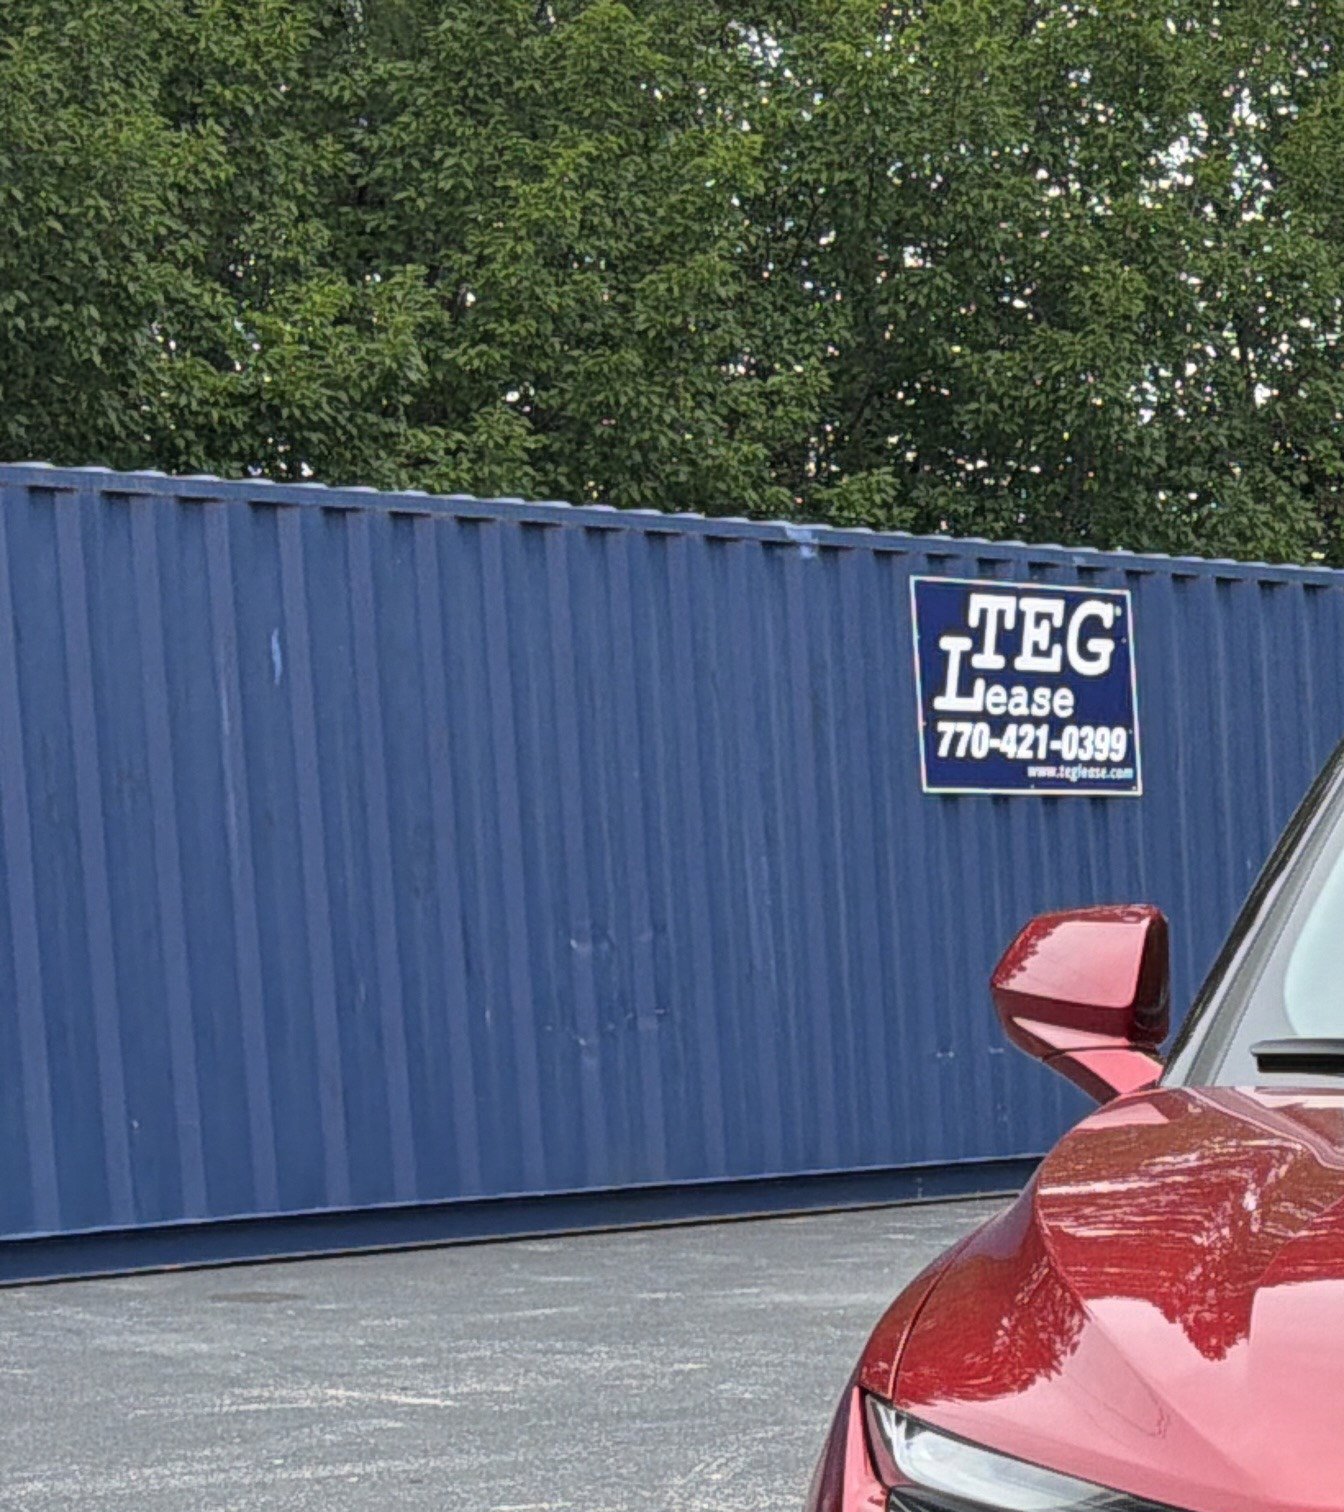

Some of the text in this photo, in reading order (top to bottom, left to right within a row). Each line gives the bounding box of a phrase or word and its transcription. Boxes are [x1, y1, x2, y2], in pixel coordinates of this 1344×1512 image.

[968, 593, 1116, 676] TEG
[933, 635, 1075, 718] Lease
[936, 721, 1128, 762] 770-421-0399
[1027, 765, 1134, 782] www.teglease.com
